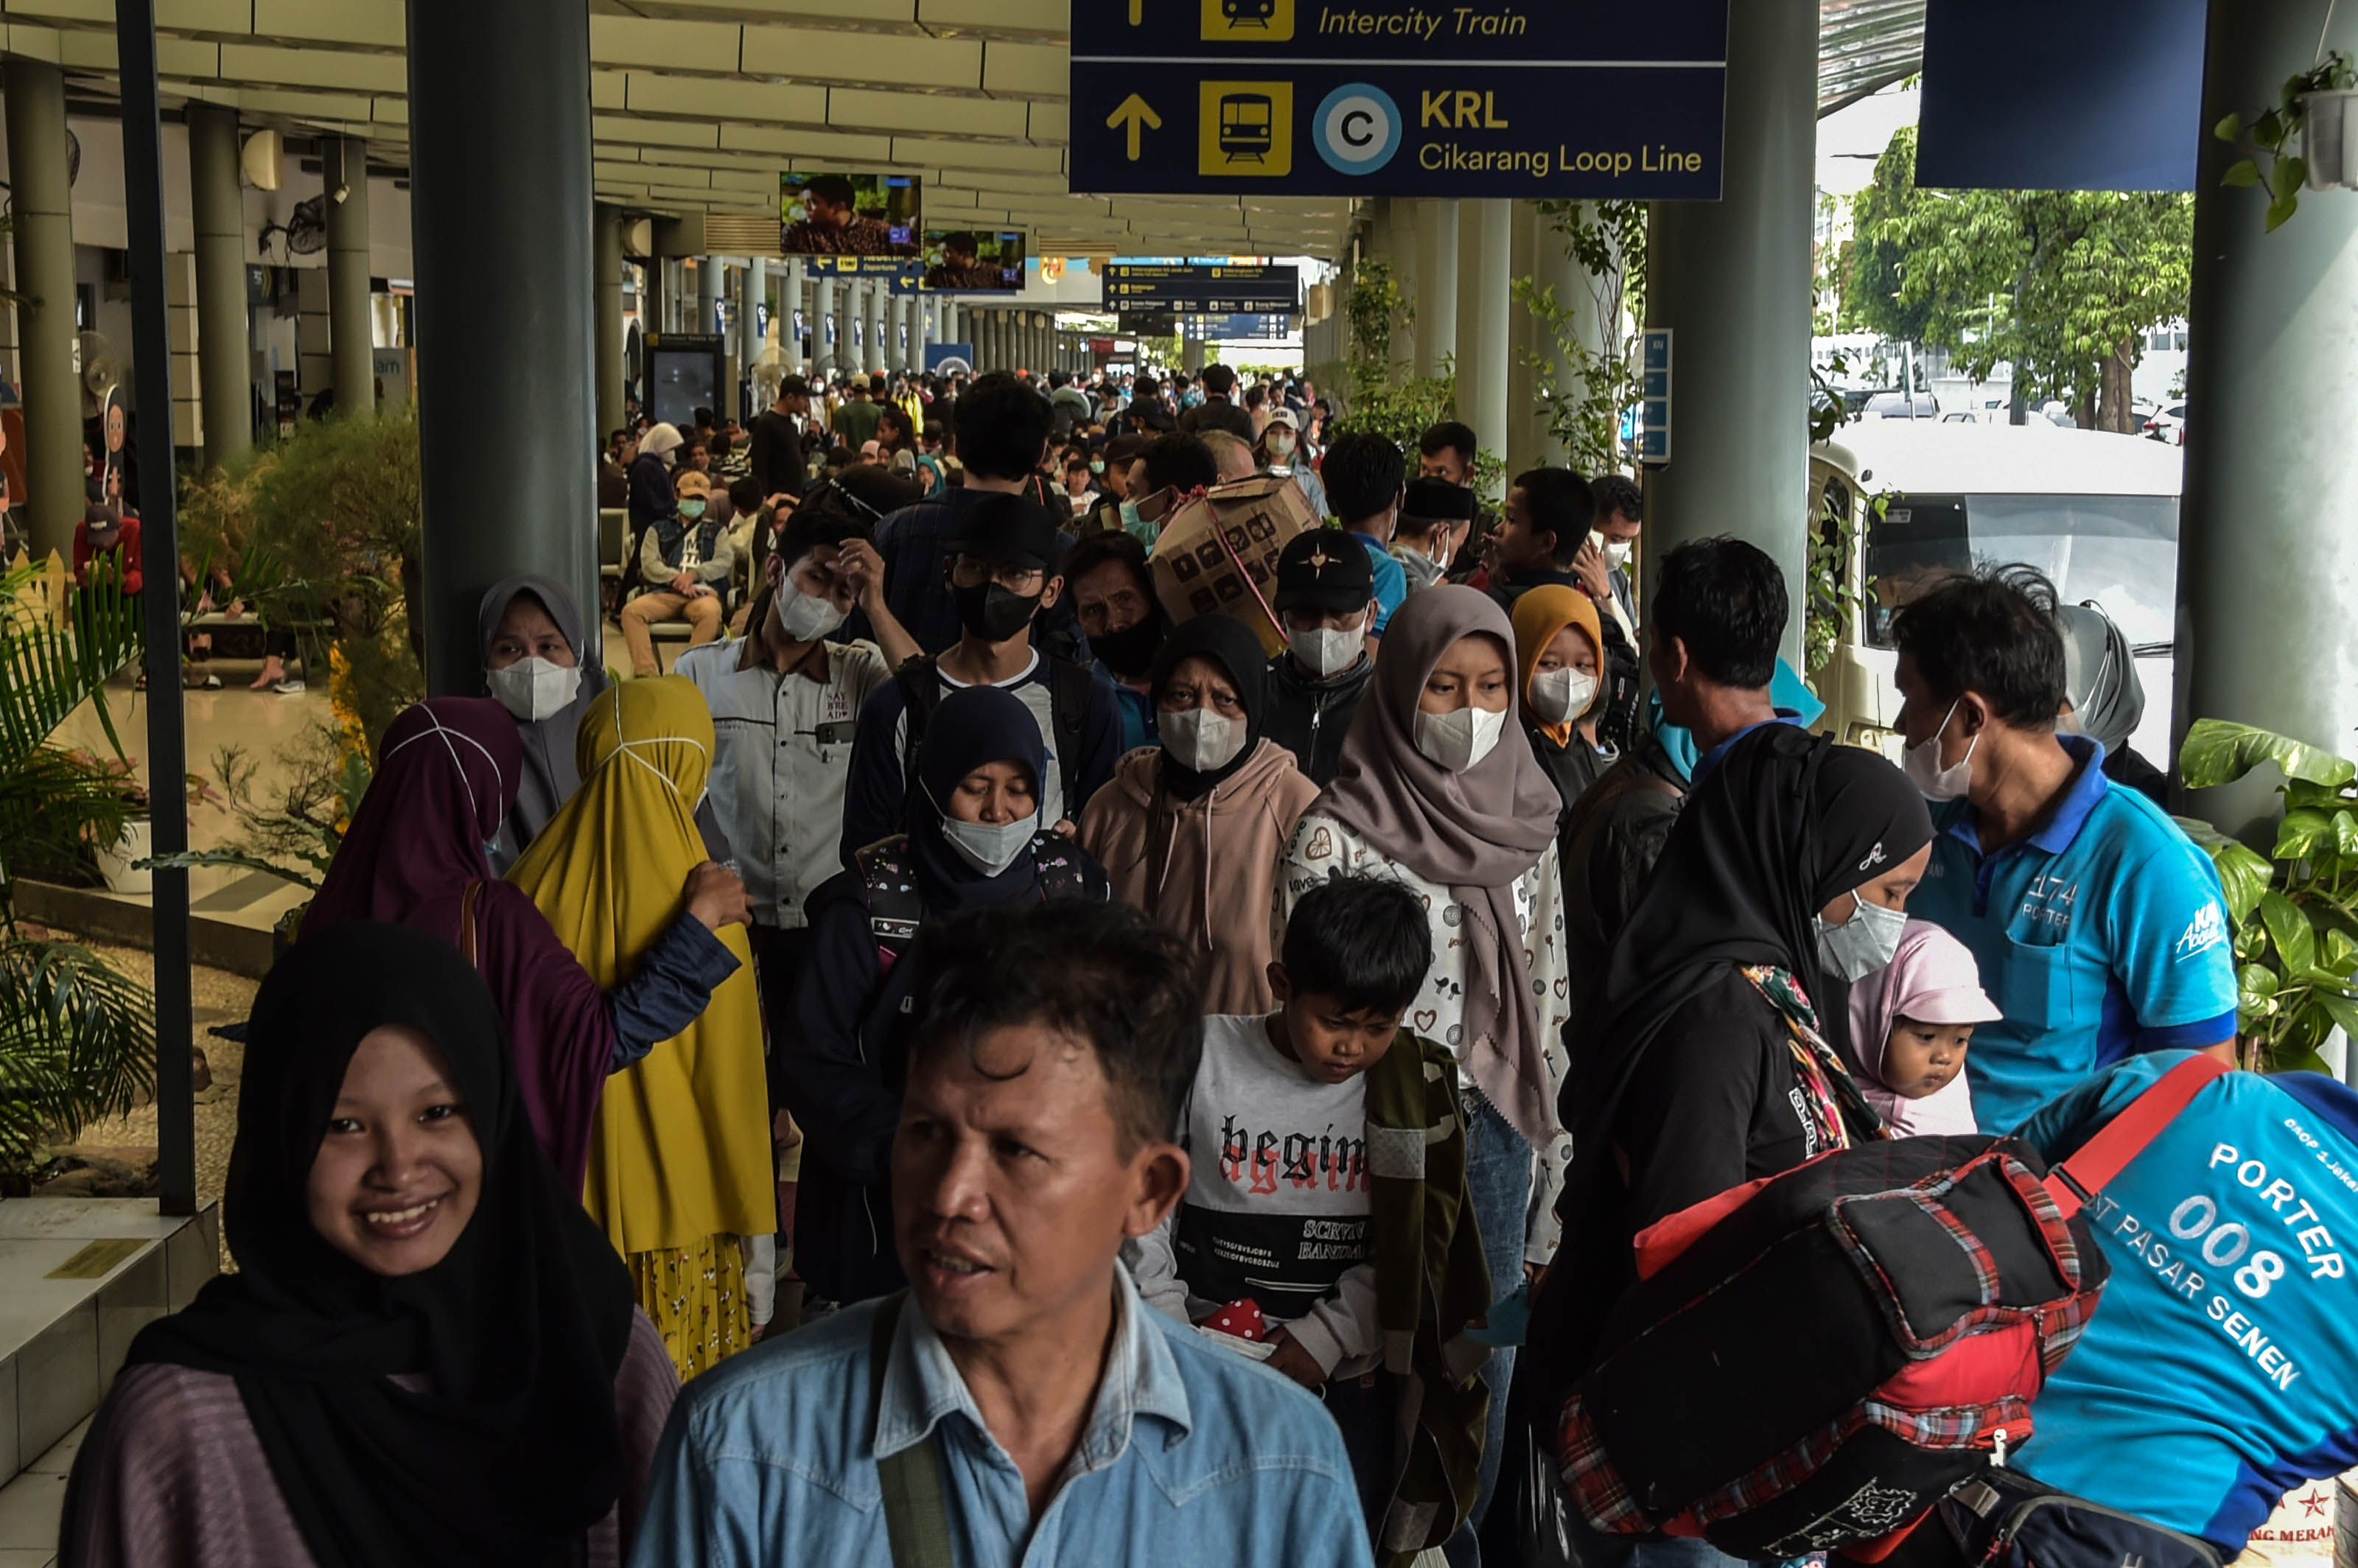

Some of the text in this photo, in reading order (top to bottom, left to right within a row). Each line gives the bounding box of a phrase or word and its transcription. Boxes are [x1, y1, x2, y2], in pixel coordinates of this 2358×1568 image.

[1319, 8, 1527, 41] Intercity Train
[1421, 90, 1508, 129] KRL
[1340, 111, 1374, 147] C
[1419, 144, 1701, 177] Cikarang Loop Line
[827, 691, 847, 701] SAY
[827, 701, 848, 711] BRE
[1288, 876, 1314, 892] love
[2028, 875, 2078, 905] 174
[2022, 904, 2071, 928] PORTER
[1221, 1115, 1365, 1180] begin
[2284, 1119, 2319, 1148] DAOP
[2209, 1141, 2346, 1281] PORTER
[2169, 1194, 2286, 1299] 008
[2113, 1214, 2206, 1300] PASAR
[2205, 1295, 2301, 1391] SENEN
